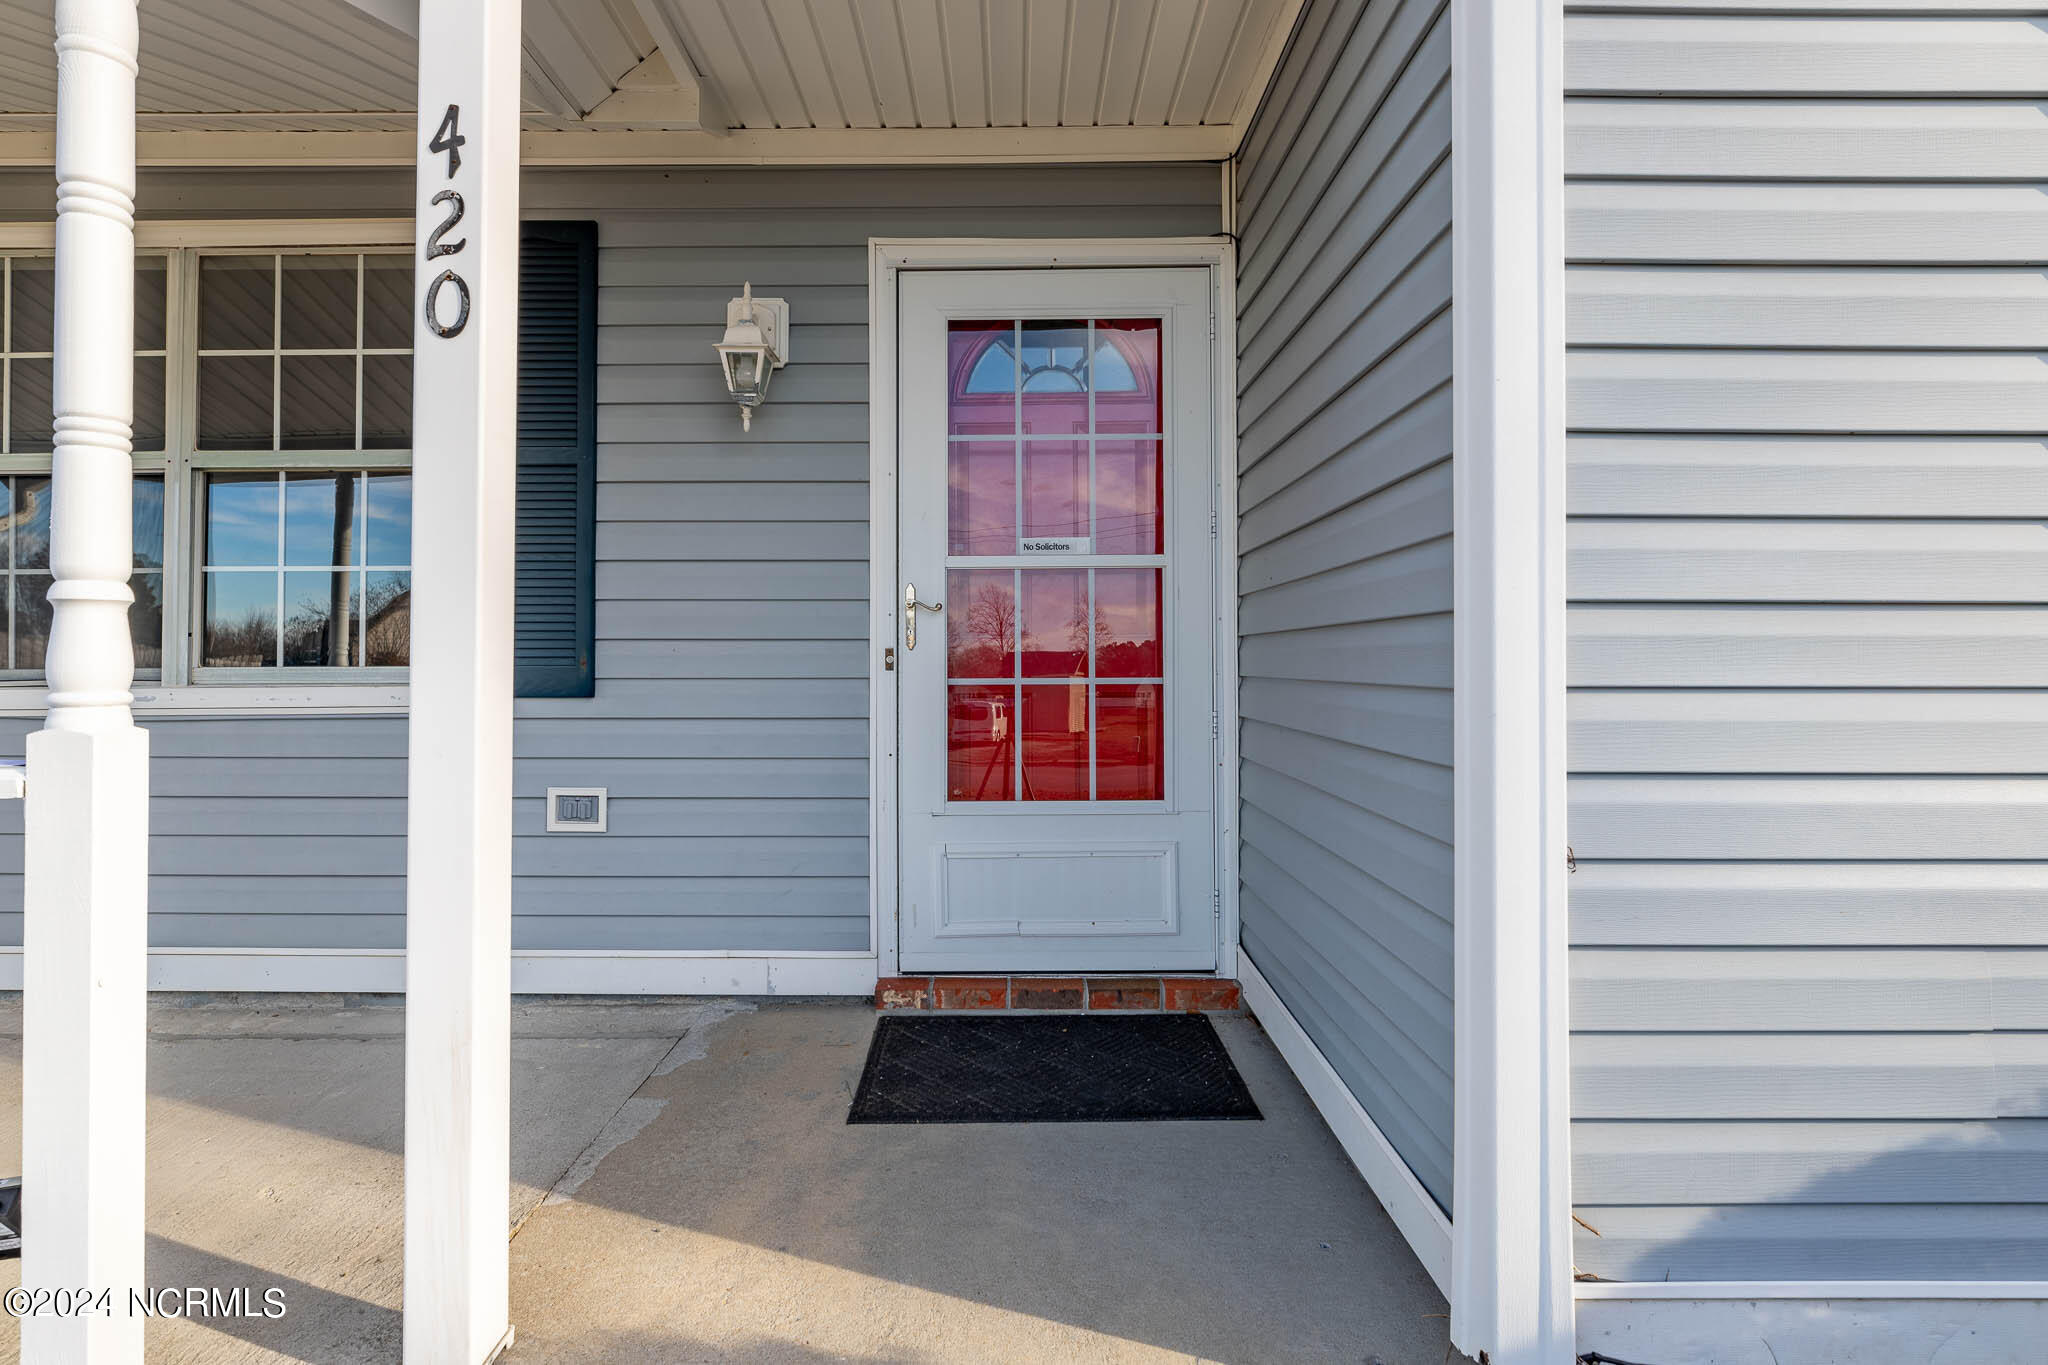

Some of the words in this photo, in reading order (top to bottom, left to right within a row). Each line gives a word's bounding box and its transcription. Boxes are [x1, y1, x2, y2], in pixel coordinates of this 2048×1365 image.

[426, 104, 470, 339] 420
[1023, 543, 1034, 551] No
[1035, 542, 1070, 551] Solicitors
